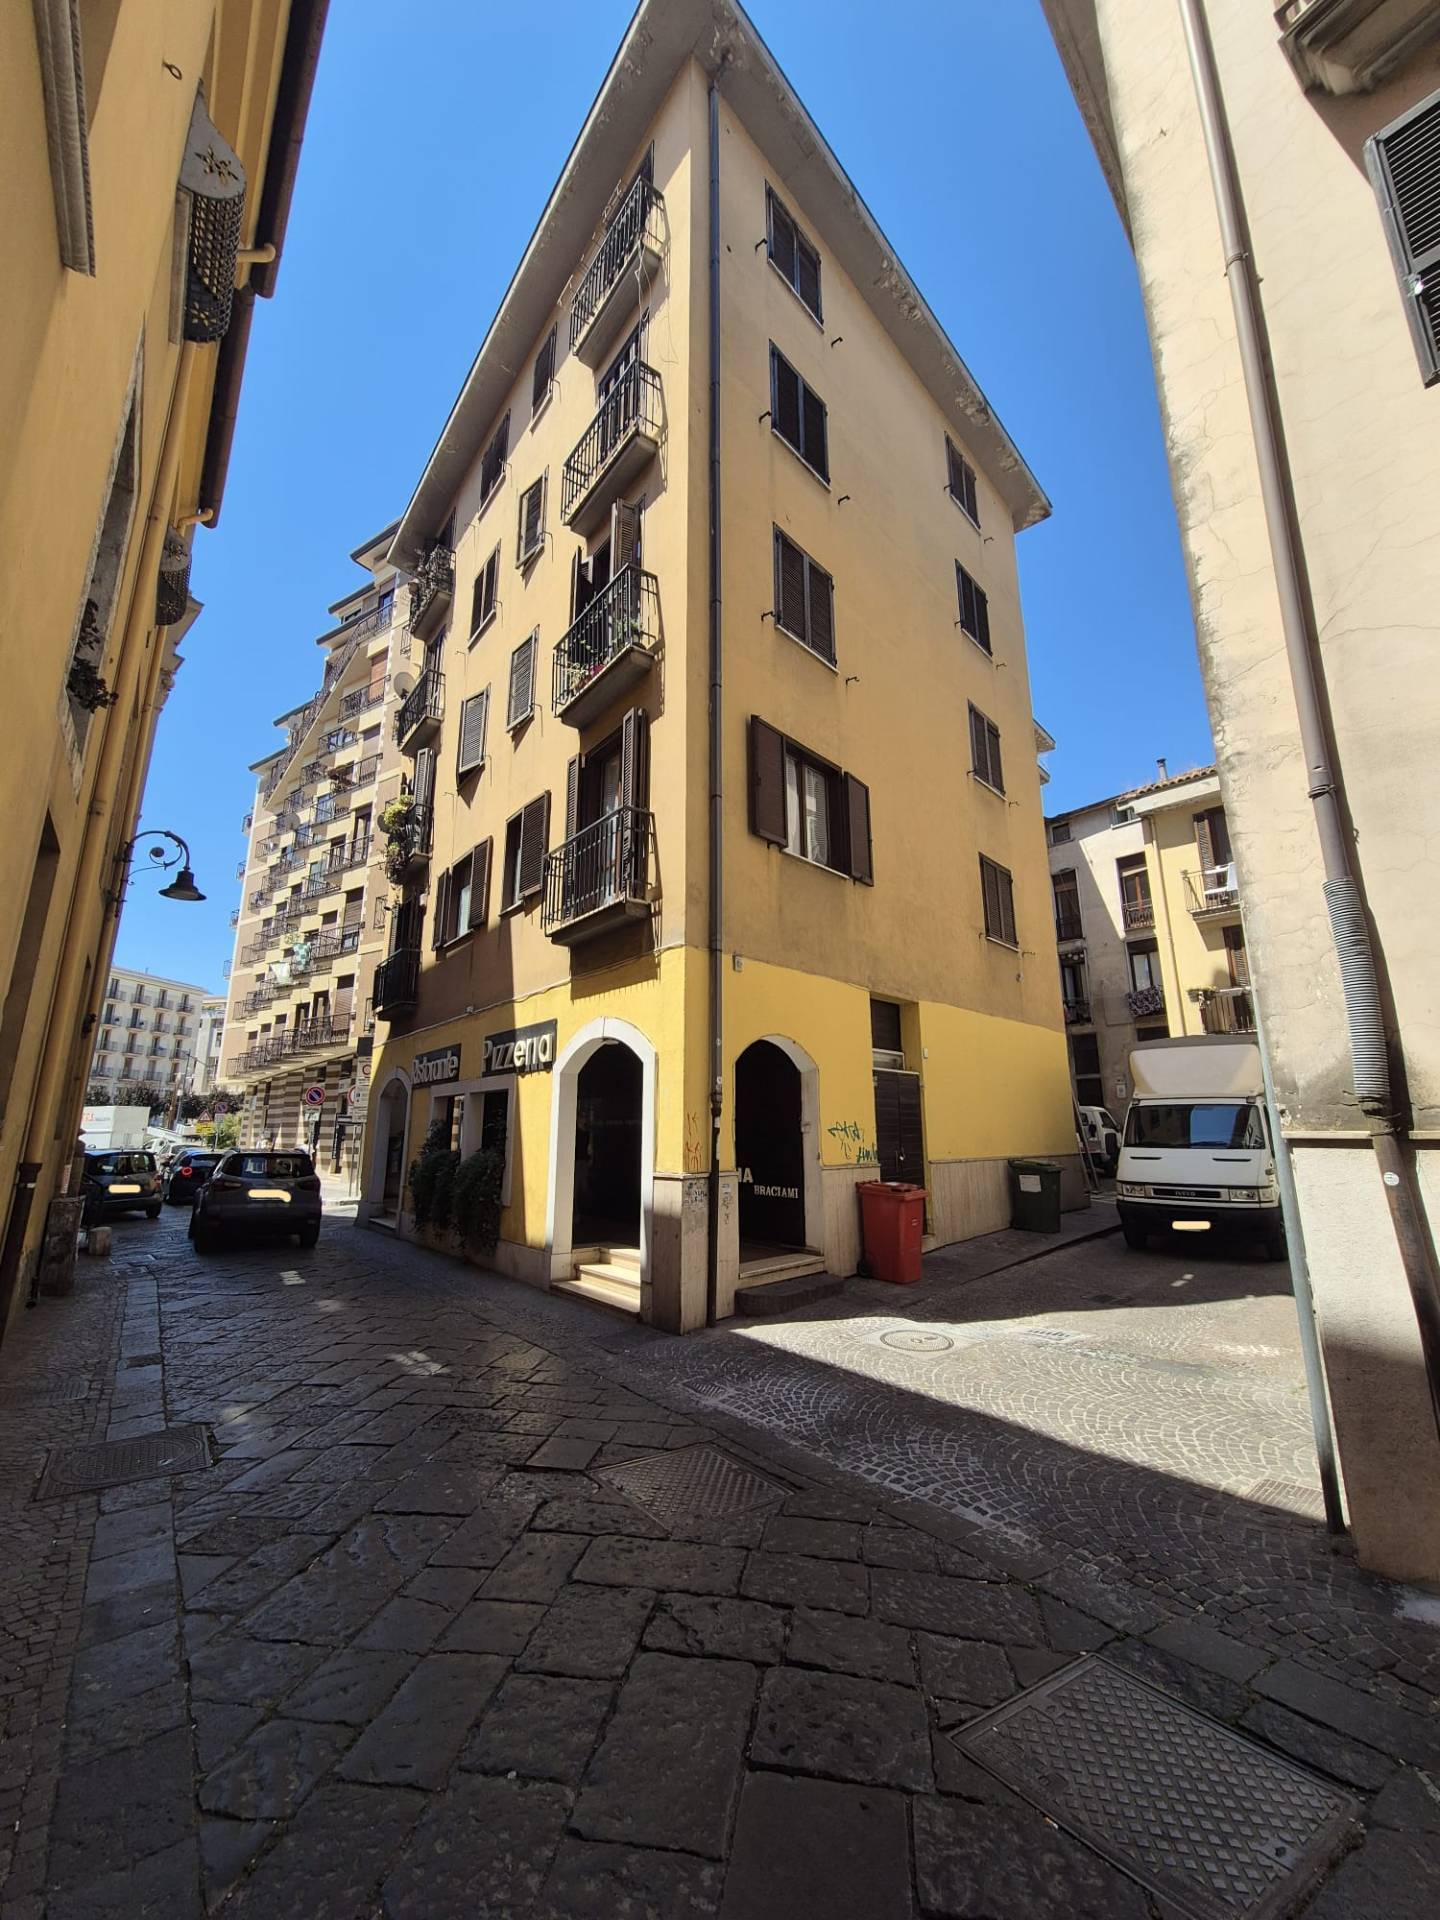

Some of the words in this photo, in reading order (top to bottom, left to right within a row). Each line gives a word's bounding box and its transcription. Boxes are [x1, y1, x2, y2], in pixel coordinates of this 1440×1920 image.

[411, 1049, 459, 1084] Ristorante
[482, 1033, 553, 1072] Pizzeria
[753, 1184, 799, 1199] BRACIAMI
